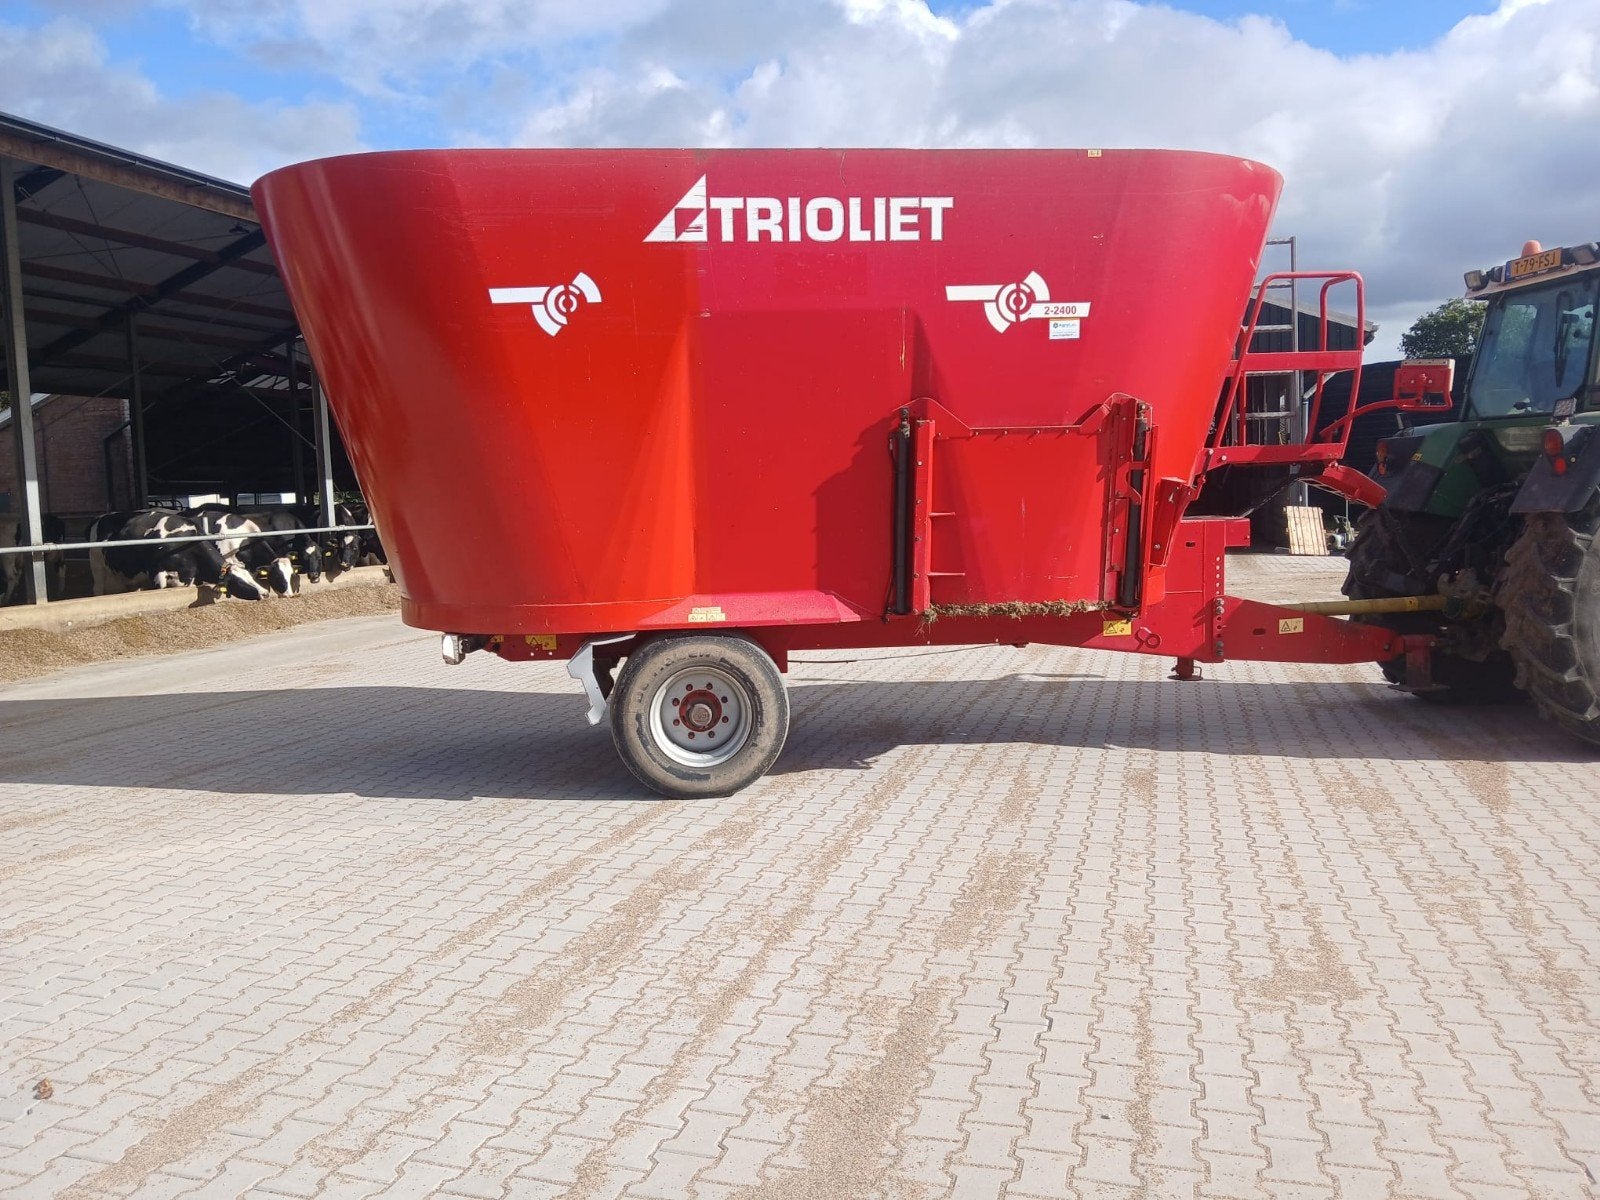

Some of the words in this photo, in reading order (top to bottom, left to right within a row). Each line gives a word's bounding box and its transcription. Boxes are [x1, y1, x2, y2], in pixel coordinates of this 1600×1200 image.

[709, 196, 954, 242] TRIOLIET
[1514, 251, 1556, 275] T-79-FSJ
[1044, 305, 1077, 315] 2-2400
